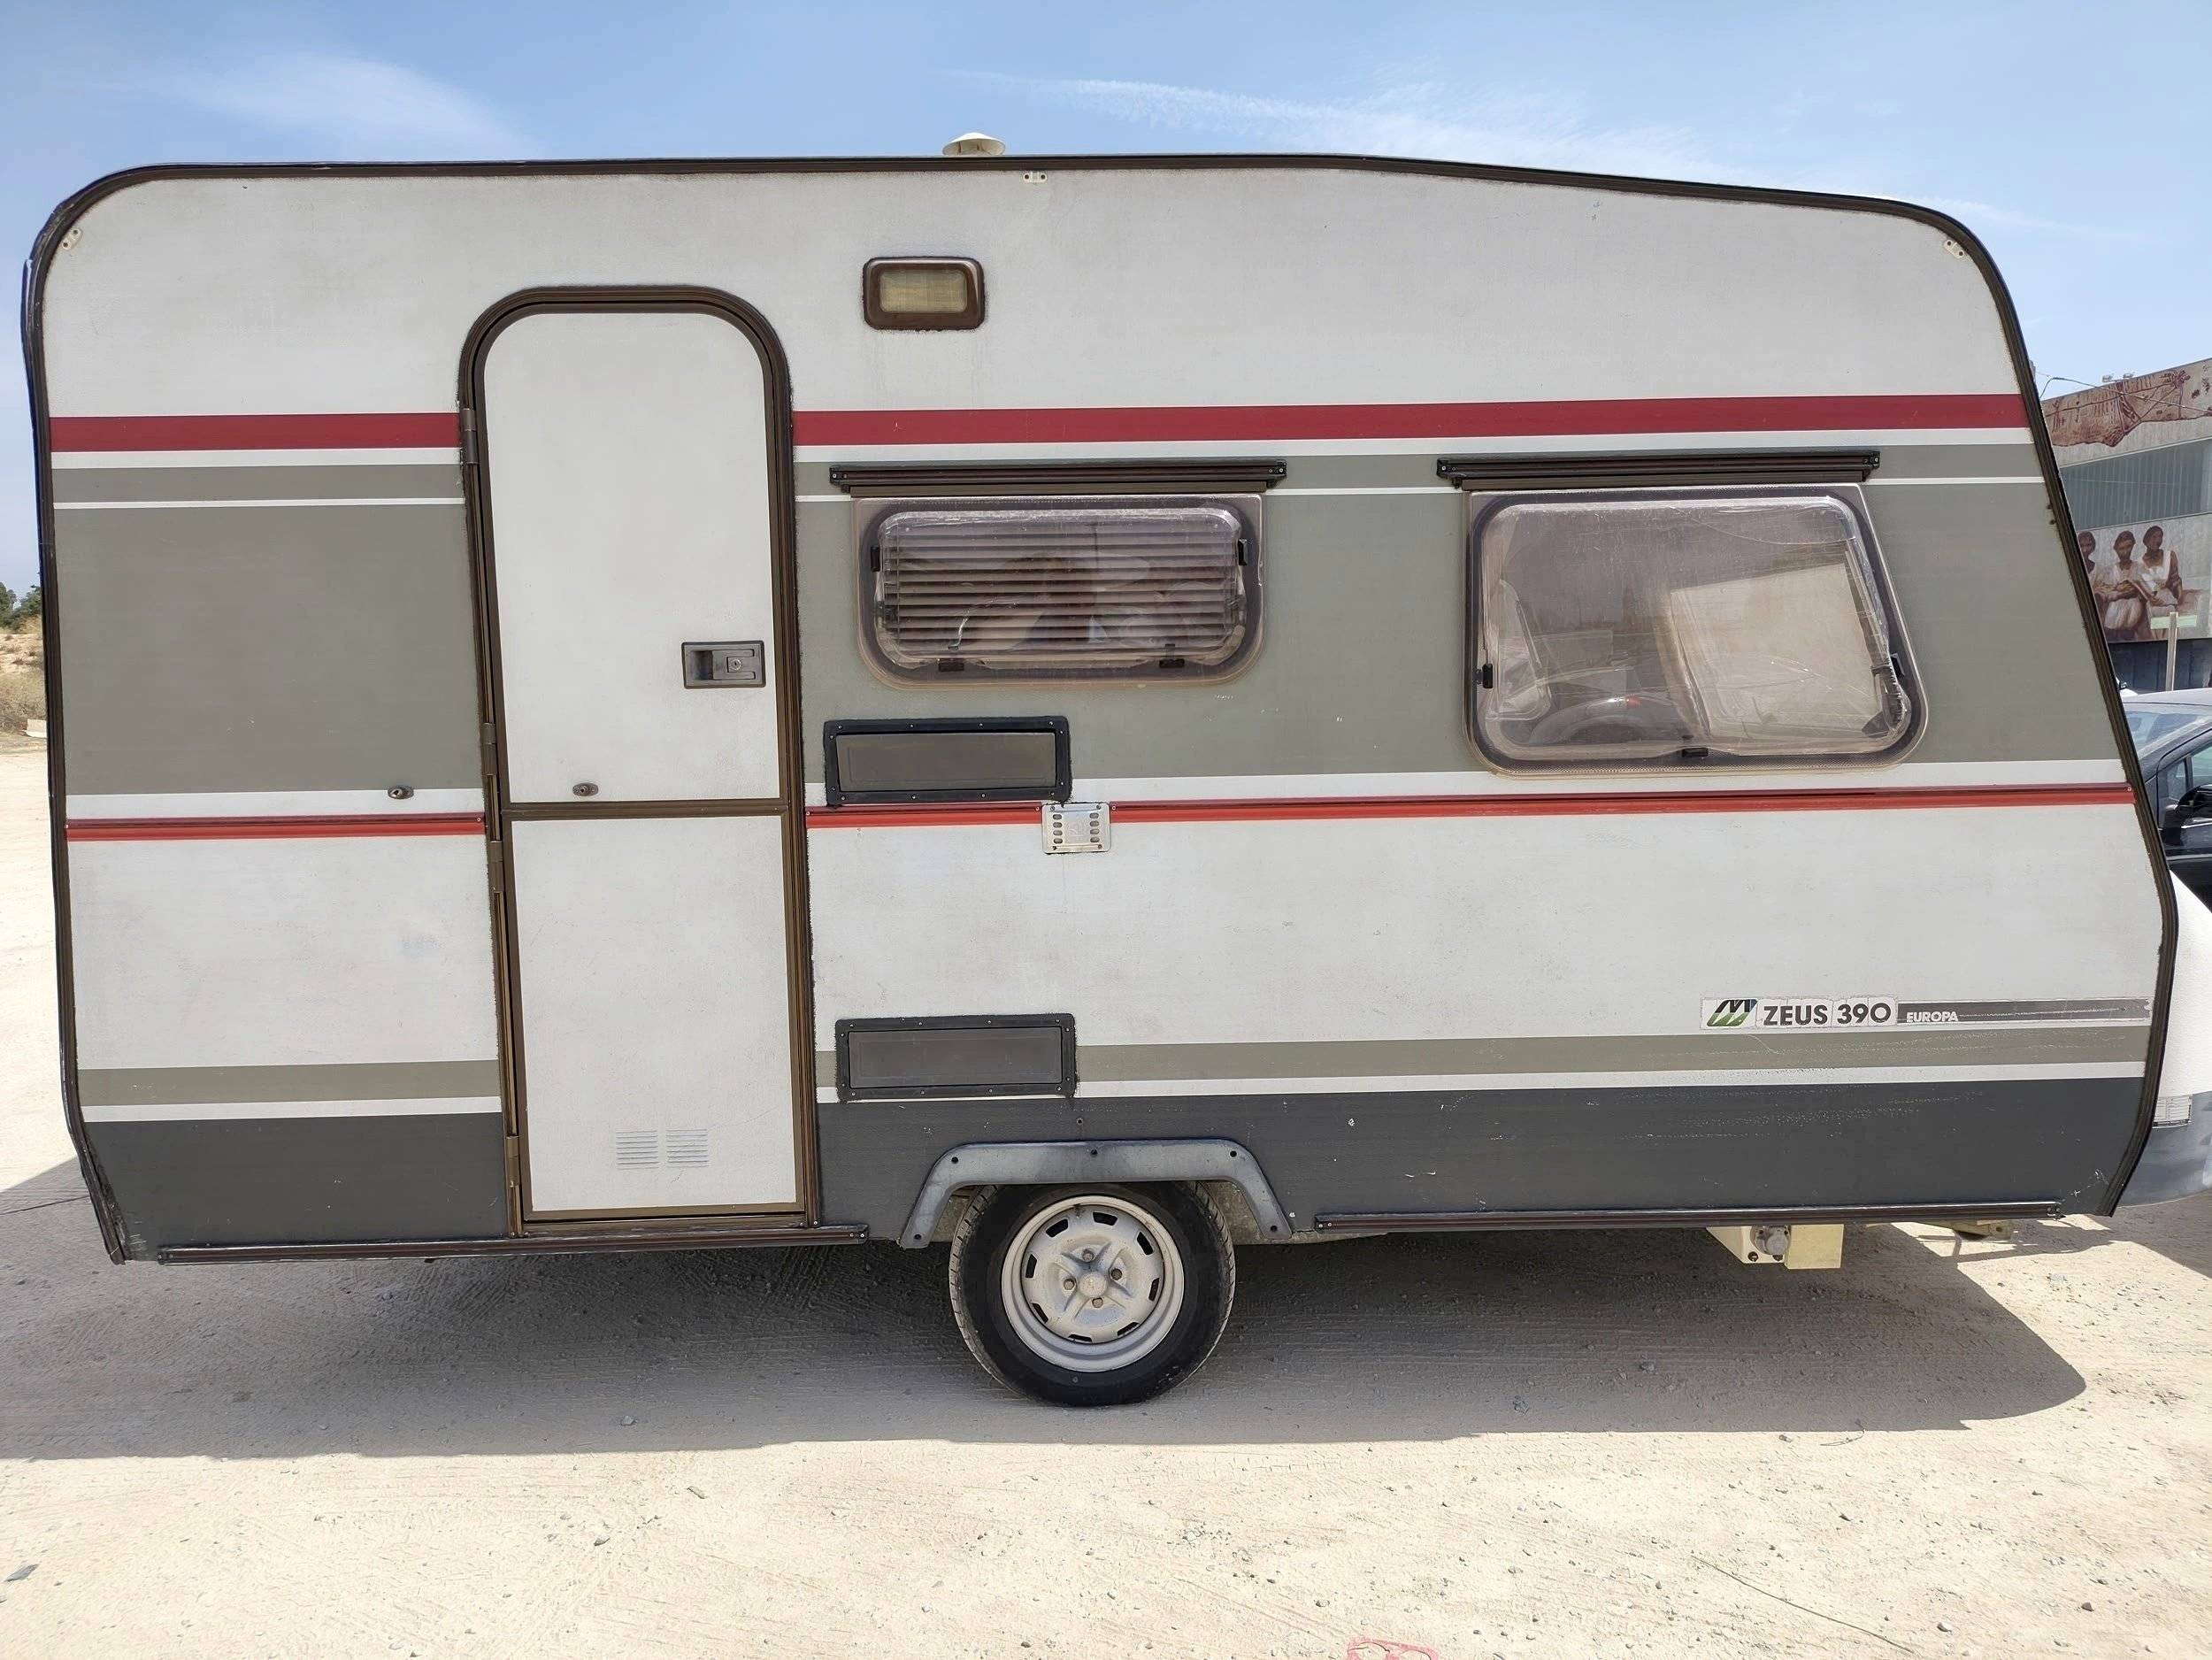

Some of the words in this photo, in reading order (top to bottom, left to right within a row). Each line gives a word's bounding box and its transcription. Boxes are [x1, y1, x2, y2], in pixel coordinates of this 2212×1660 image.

[1763, 1004, 1829, 1026] ZEUS
[1837, 1002, 1892, 1025] 390
[1906, 1011, 1959, 1023] EUROPA
